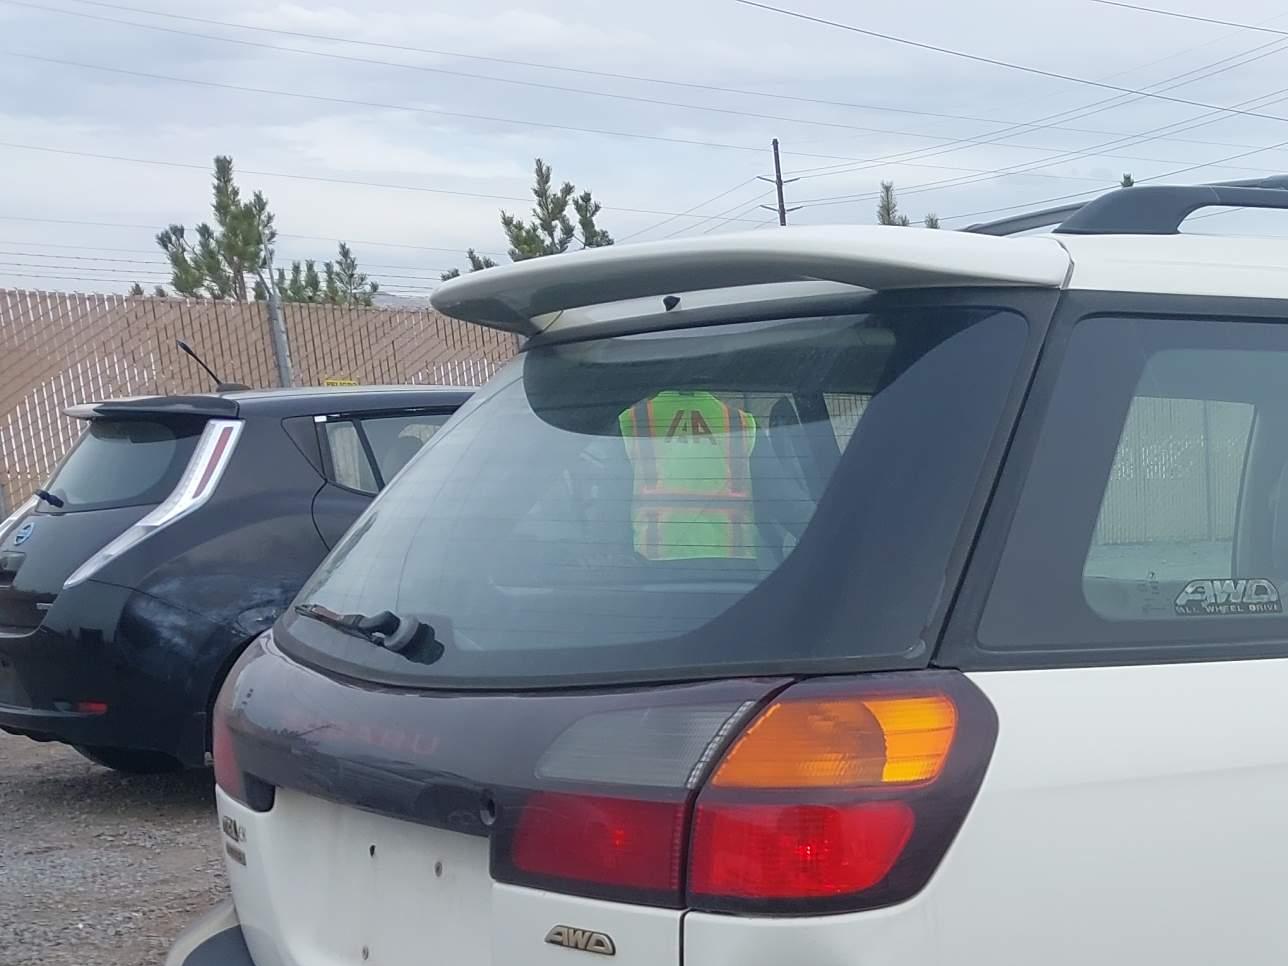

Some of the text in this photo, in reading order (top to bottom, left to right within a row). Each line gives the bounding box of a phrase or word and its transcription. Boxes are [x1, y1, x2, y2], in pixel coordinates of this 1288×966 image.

[1176, 579, 1279, 605] AWD
[1205, 604, 1244, 613] WHEEL
[544, 925, 615, 956] AWD
